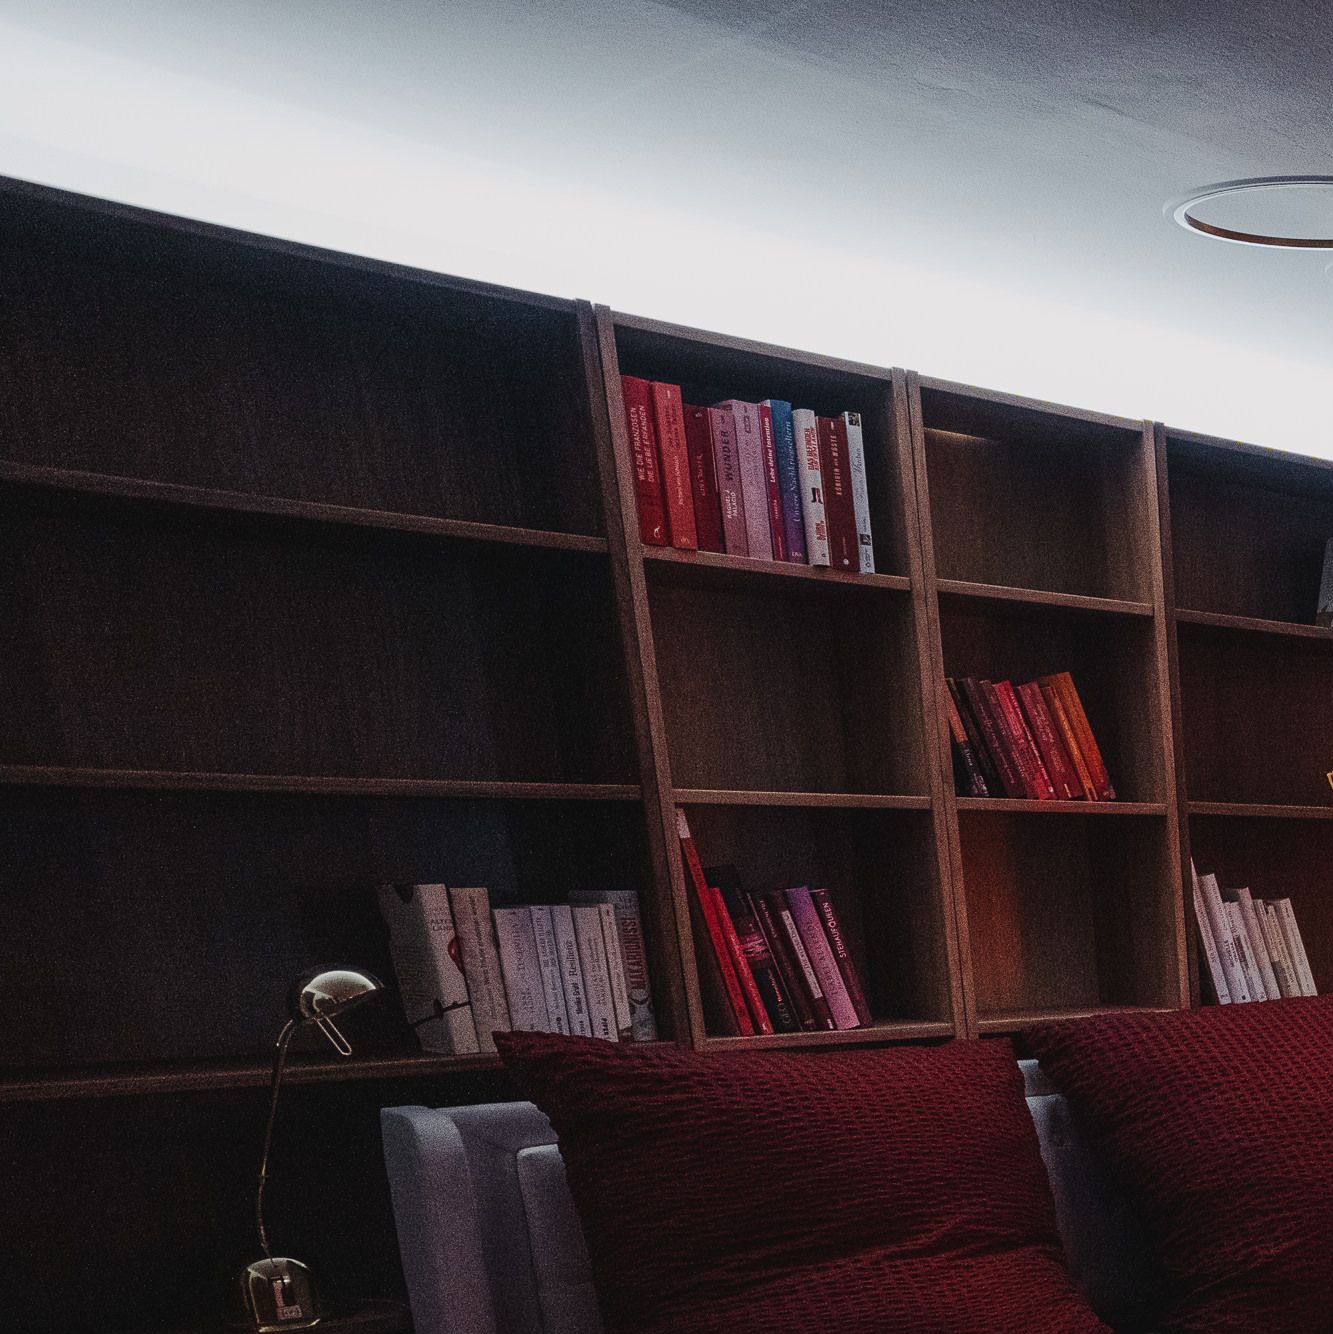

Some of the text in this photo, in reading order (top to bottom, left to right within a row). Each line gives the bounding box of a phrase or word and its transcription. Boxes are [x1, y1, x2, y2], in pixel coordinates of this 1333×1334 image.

[630, 407, 646, 481] WIE DIE FRANZOSEN
[638, 405, 655, 482] DIE LIEBE ERFANDEN
[720, 430, 734, 481] WUNDER
[764, 417, 776, 483] Lebe deine Intention
[784, 421, 801, 522] Unsere Nachkriegseltern
[566, 940, 578, 976] Resilienz
[620, 917, 646, 990] MAKARIONISSI
[822, 901, 847, 958] STEHAUFQUEEN
